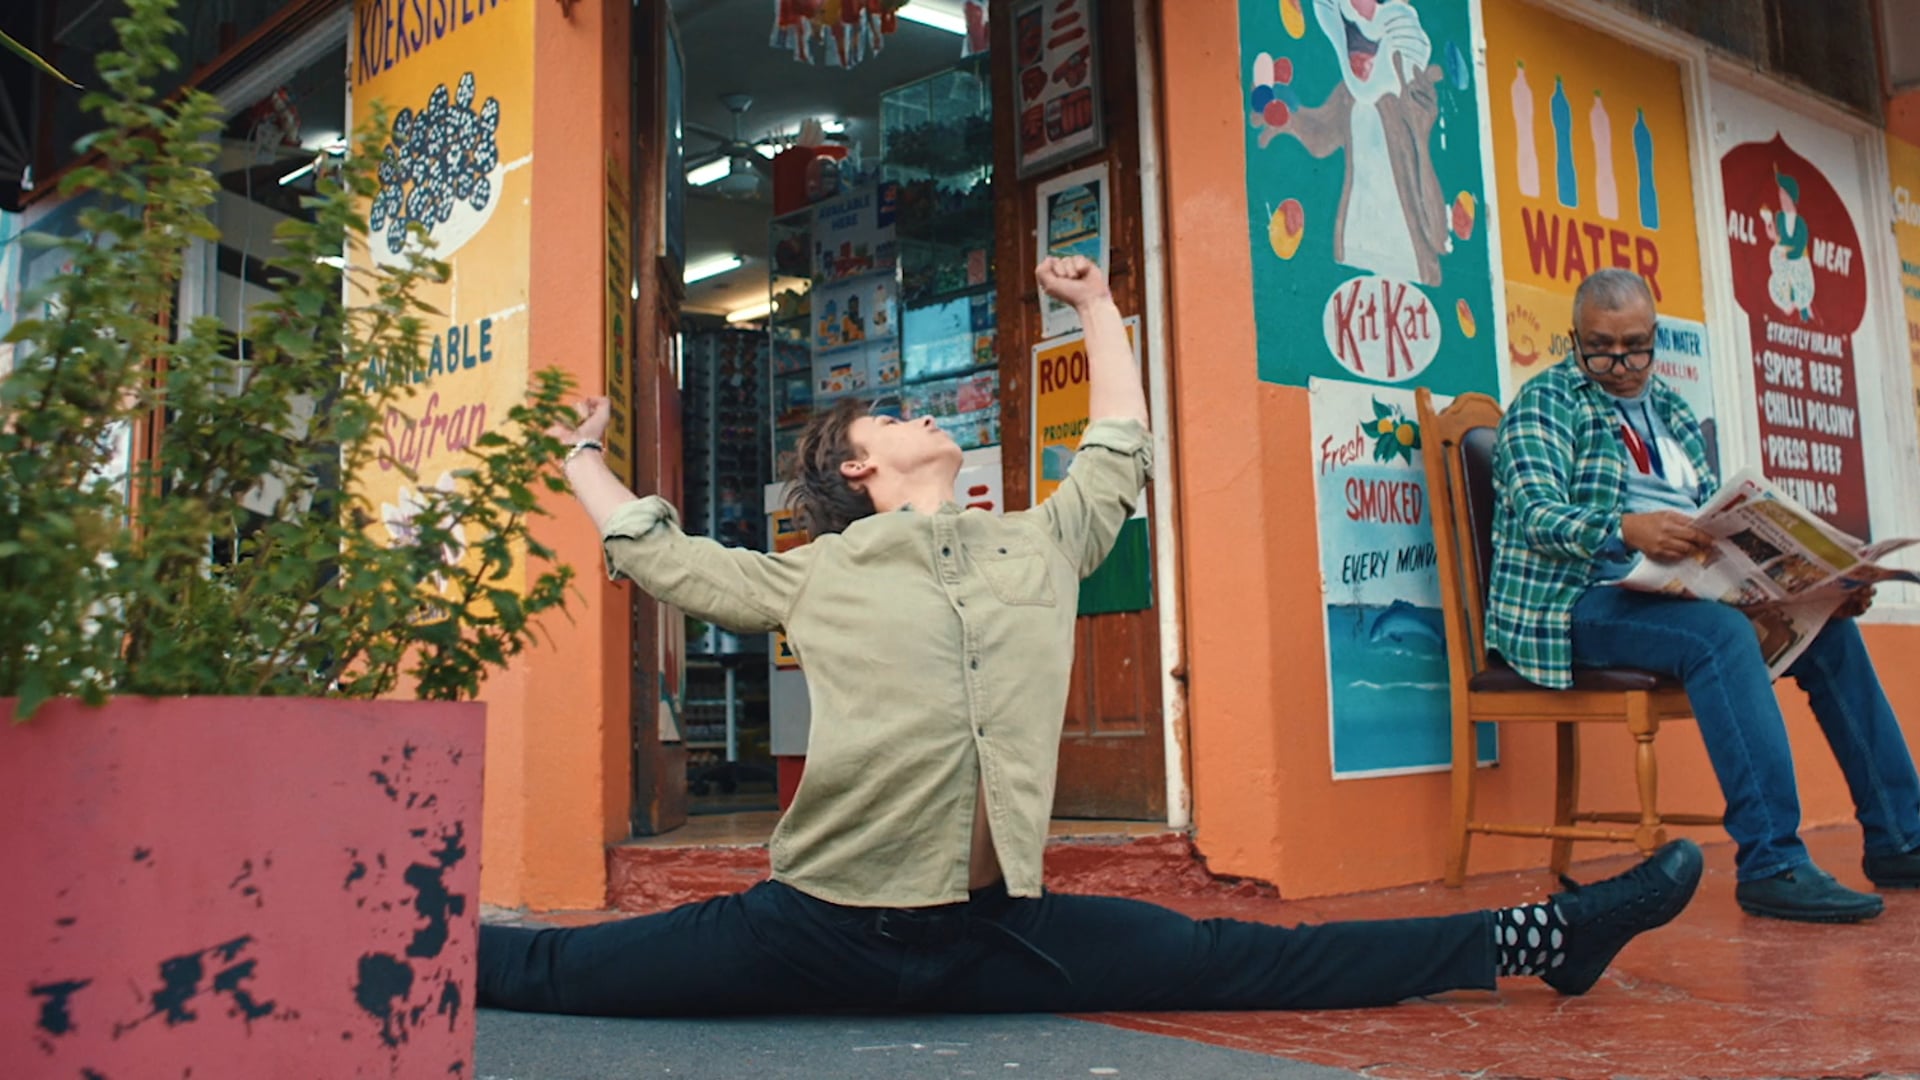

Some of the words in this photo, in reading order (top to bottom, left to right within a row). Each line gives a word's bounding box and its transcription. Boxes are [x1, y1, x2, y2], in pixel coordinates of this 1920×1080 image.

[358, 0, 498, 85] KOEKSIS
[1521, 206, 1662, 303] WATER
[1728, 209, 1757, 245] ALL
[1812, 237, 1852, 278] MEAT
[364, 318, 493, 394] AVABLE
[1653, 361, 1699, 383] PARKLING
[1763, 349, 1804, 390] SPICE
[1809, 360, 1843, 398] BEEF
[378, 391, 486, 471] Safran
[1764, 389, 1804, 429] CHILLI
[1806, 398, 1855, 439] POLONY
[1321, 424, 1365, 476] Fresh
[1768, 433, 1809, 471] PRESS
[1811, 441, 1843, 476] BEEF
[1345, 476, 1423, 526] SMOKED
[1772, 476, 1838, 515] ENNAS
[1342, 550, 1390, 585] EVERY
